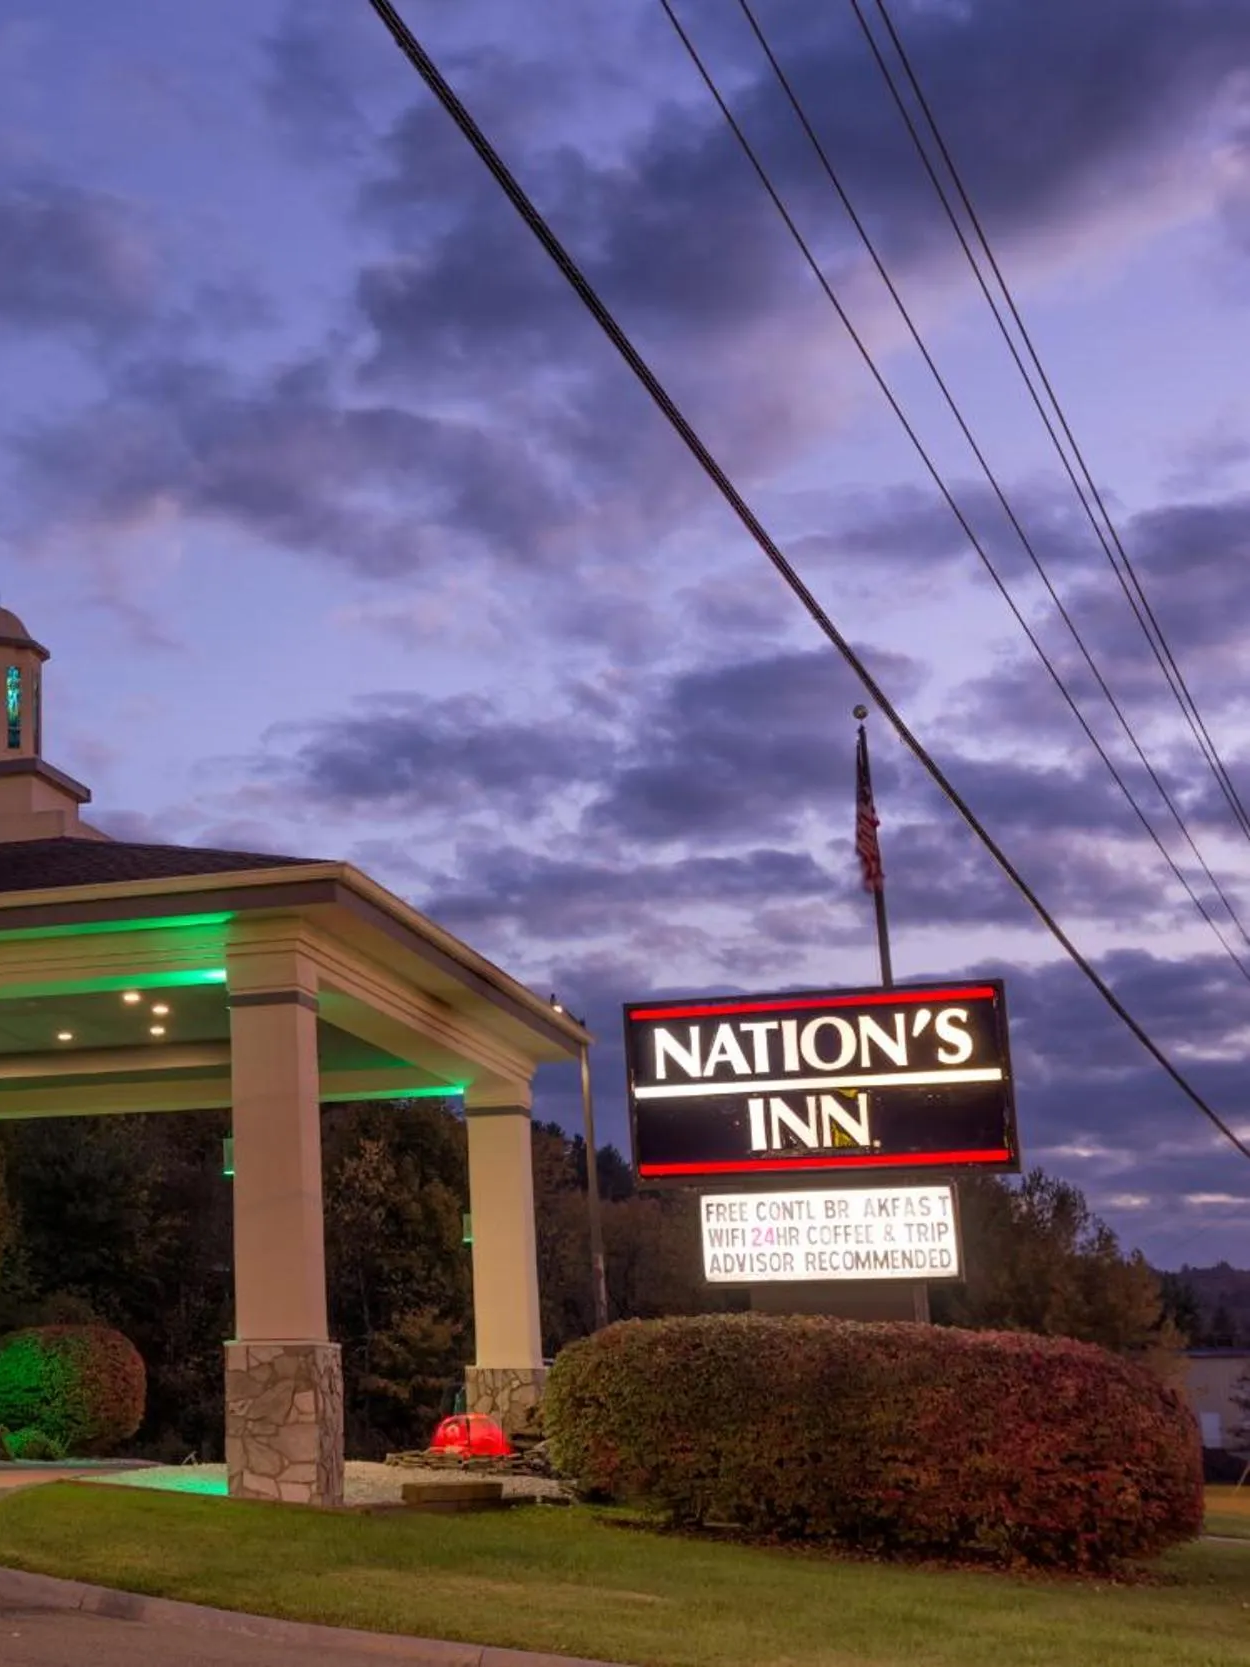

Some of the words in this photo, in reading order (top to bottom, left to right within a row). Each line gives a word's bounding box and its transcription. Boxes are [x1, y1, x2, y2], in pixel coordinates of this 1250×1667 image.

[654, 1008, 973, 1080] NATION'S
[748, 1093, 871, 1151] INN
[705, 1202, 749, 1223] FREE
[756, 1200, 815, 1221] CONTL
[708, 1227, 746, 1248] WIFI
[751, 1226, 800, 1247] 24HR
[807, 1224, 874, 1246] COFFEE
[903, 1221, 949, 1243] TRIP
[710, 1252, 795, 1274] ADVISOR
[805, 1248, 952, 1272] RECOMMENDED
